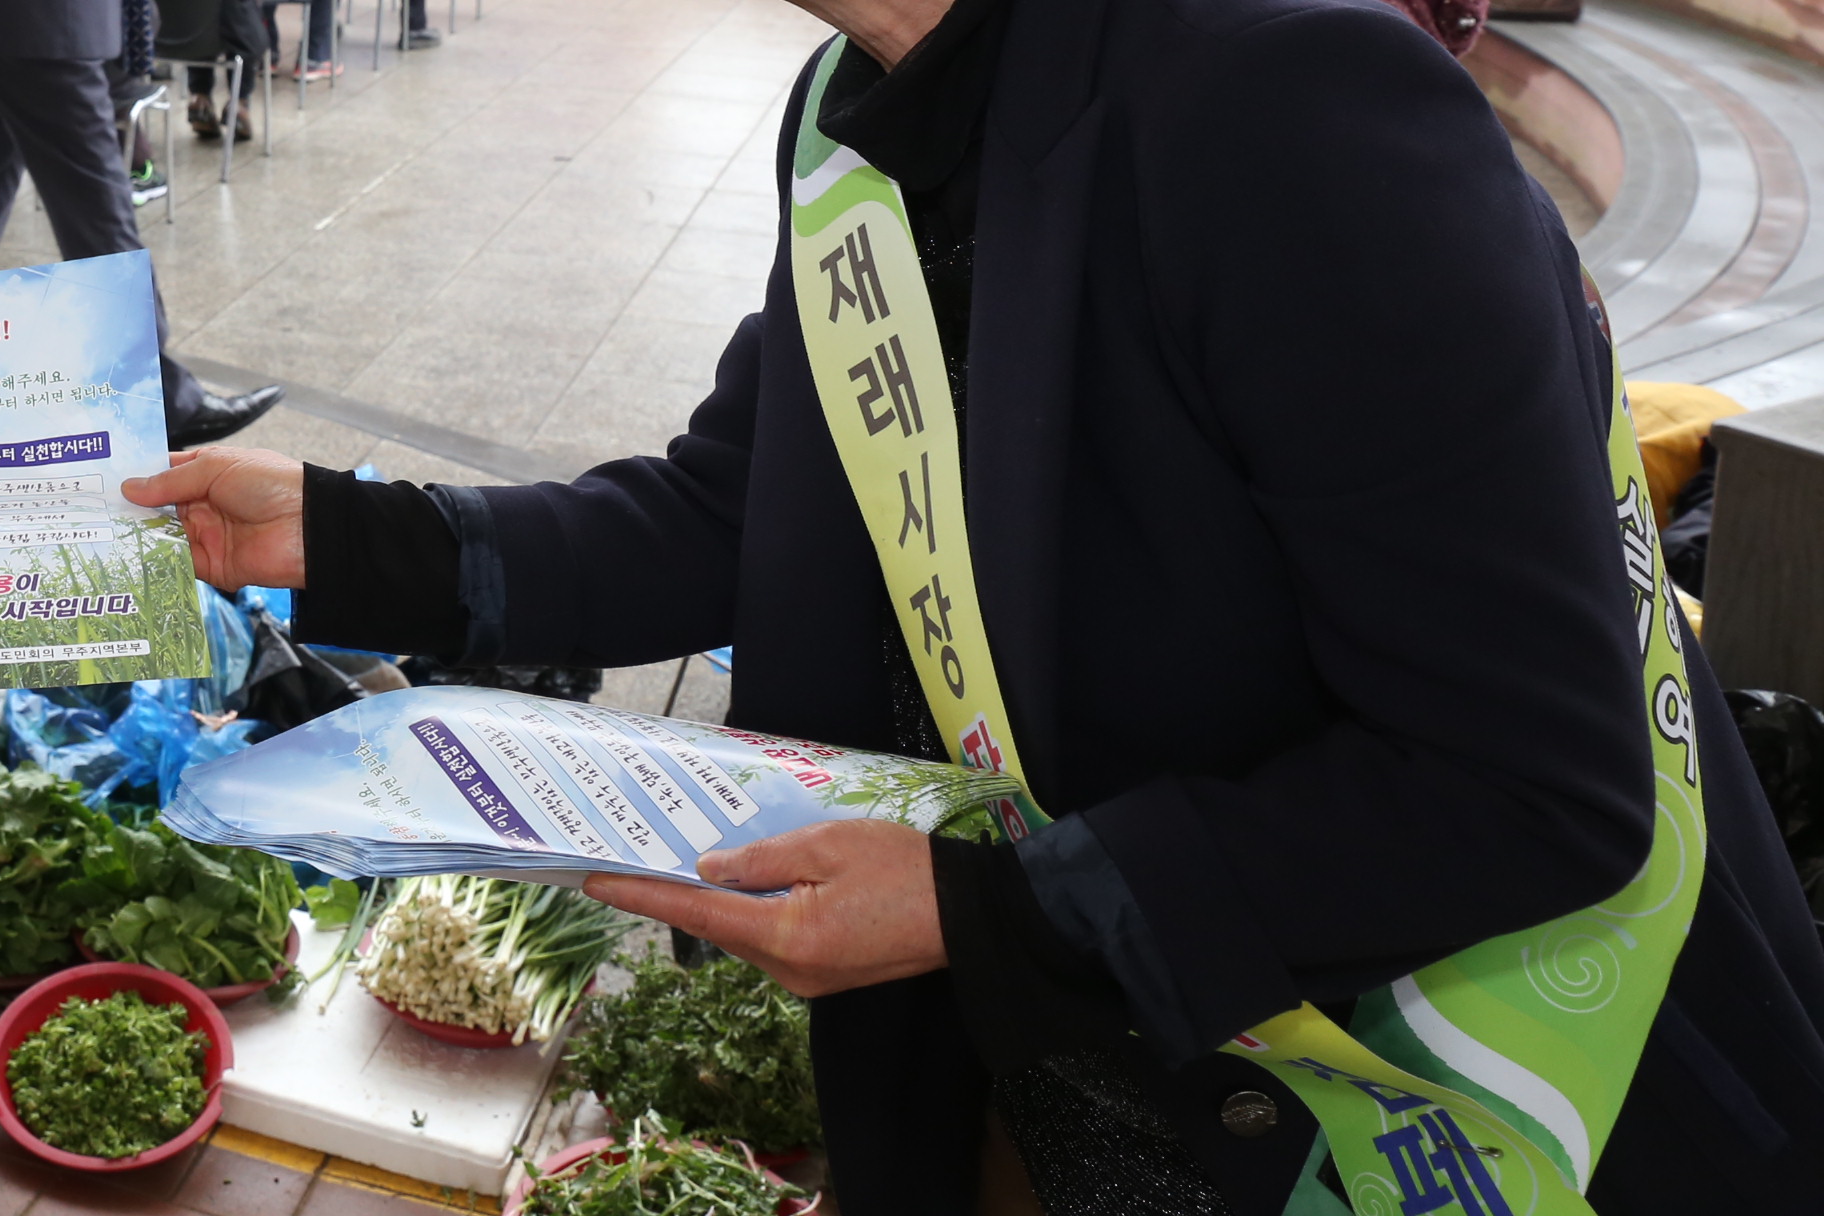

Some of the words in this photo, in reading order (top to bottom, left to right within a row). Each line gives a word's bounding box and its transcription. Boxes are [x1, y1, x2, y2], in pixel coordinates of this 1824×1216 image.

[24, 389, 64, 407] 하시면
[70, 383, 118, 401] 됩니다.
[21, 436, 104, 463] 실천합시다!!
[819, 222, 965, 700] 재래시장
[1, 594, 138, 621] 시작입니다.
[62, 642, 143, 659] 무주지역본부
[417, 721, 479, 783] 실천합시다!!
[761, 747, 834, 789] 내고장
[467, 781, 510, 829] 이것부터
[695, 765, 744, 811] 재래시장
[626, 821, 651, 847] 믿고
